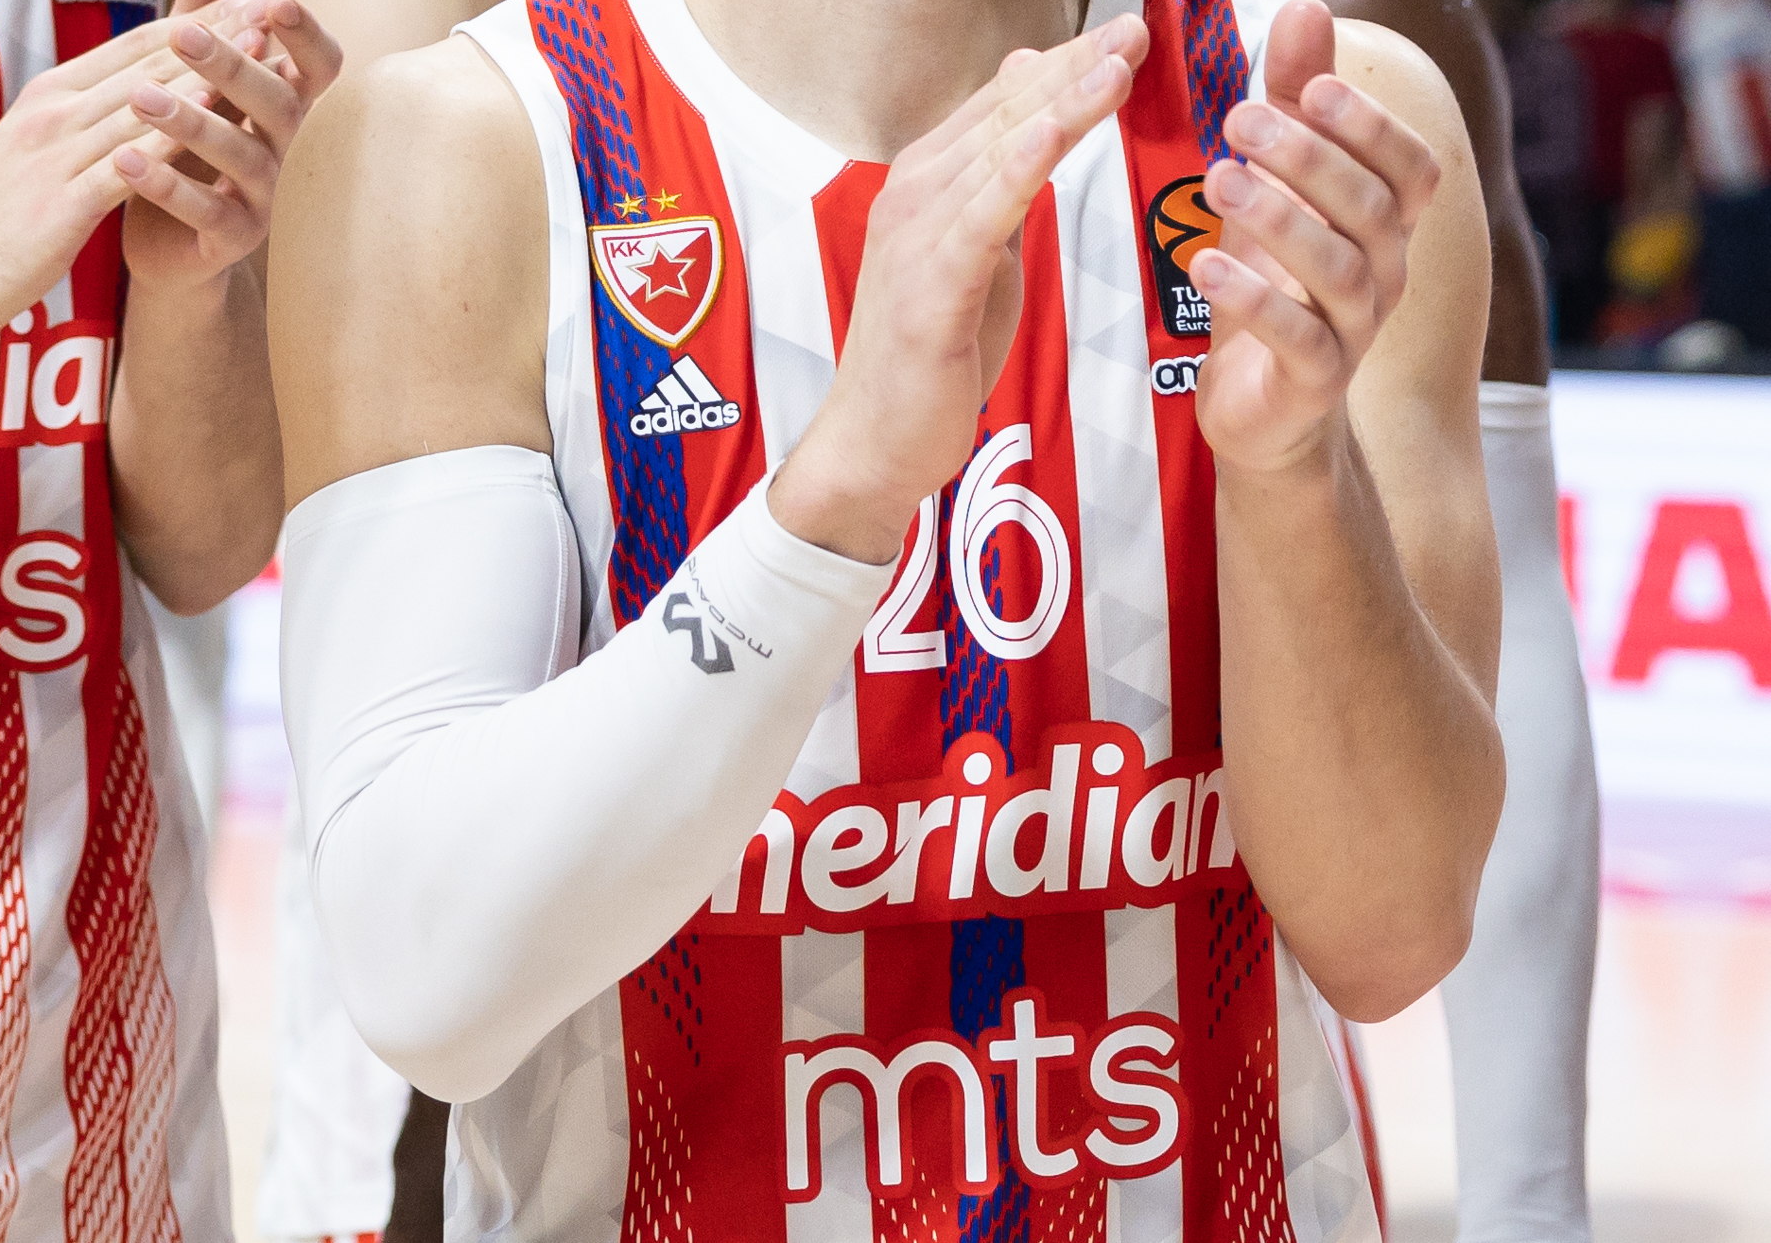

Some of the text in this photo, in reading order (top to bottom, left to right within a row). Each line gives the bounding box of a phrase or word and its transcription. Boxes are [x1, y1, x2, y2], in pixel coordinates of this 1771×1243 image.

[610, 240, 645, 259] KK
[630, 401, 740, 437] adidas
[864, 423, 1070, 674] 26
[785, 999, 1181, 1190] mts
